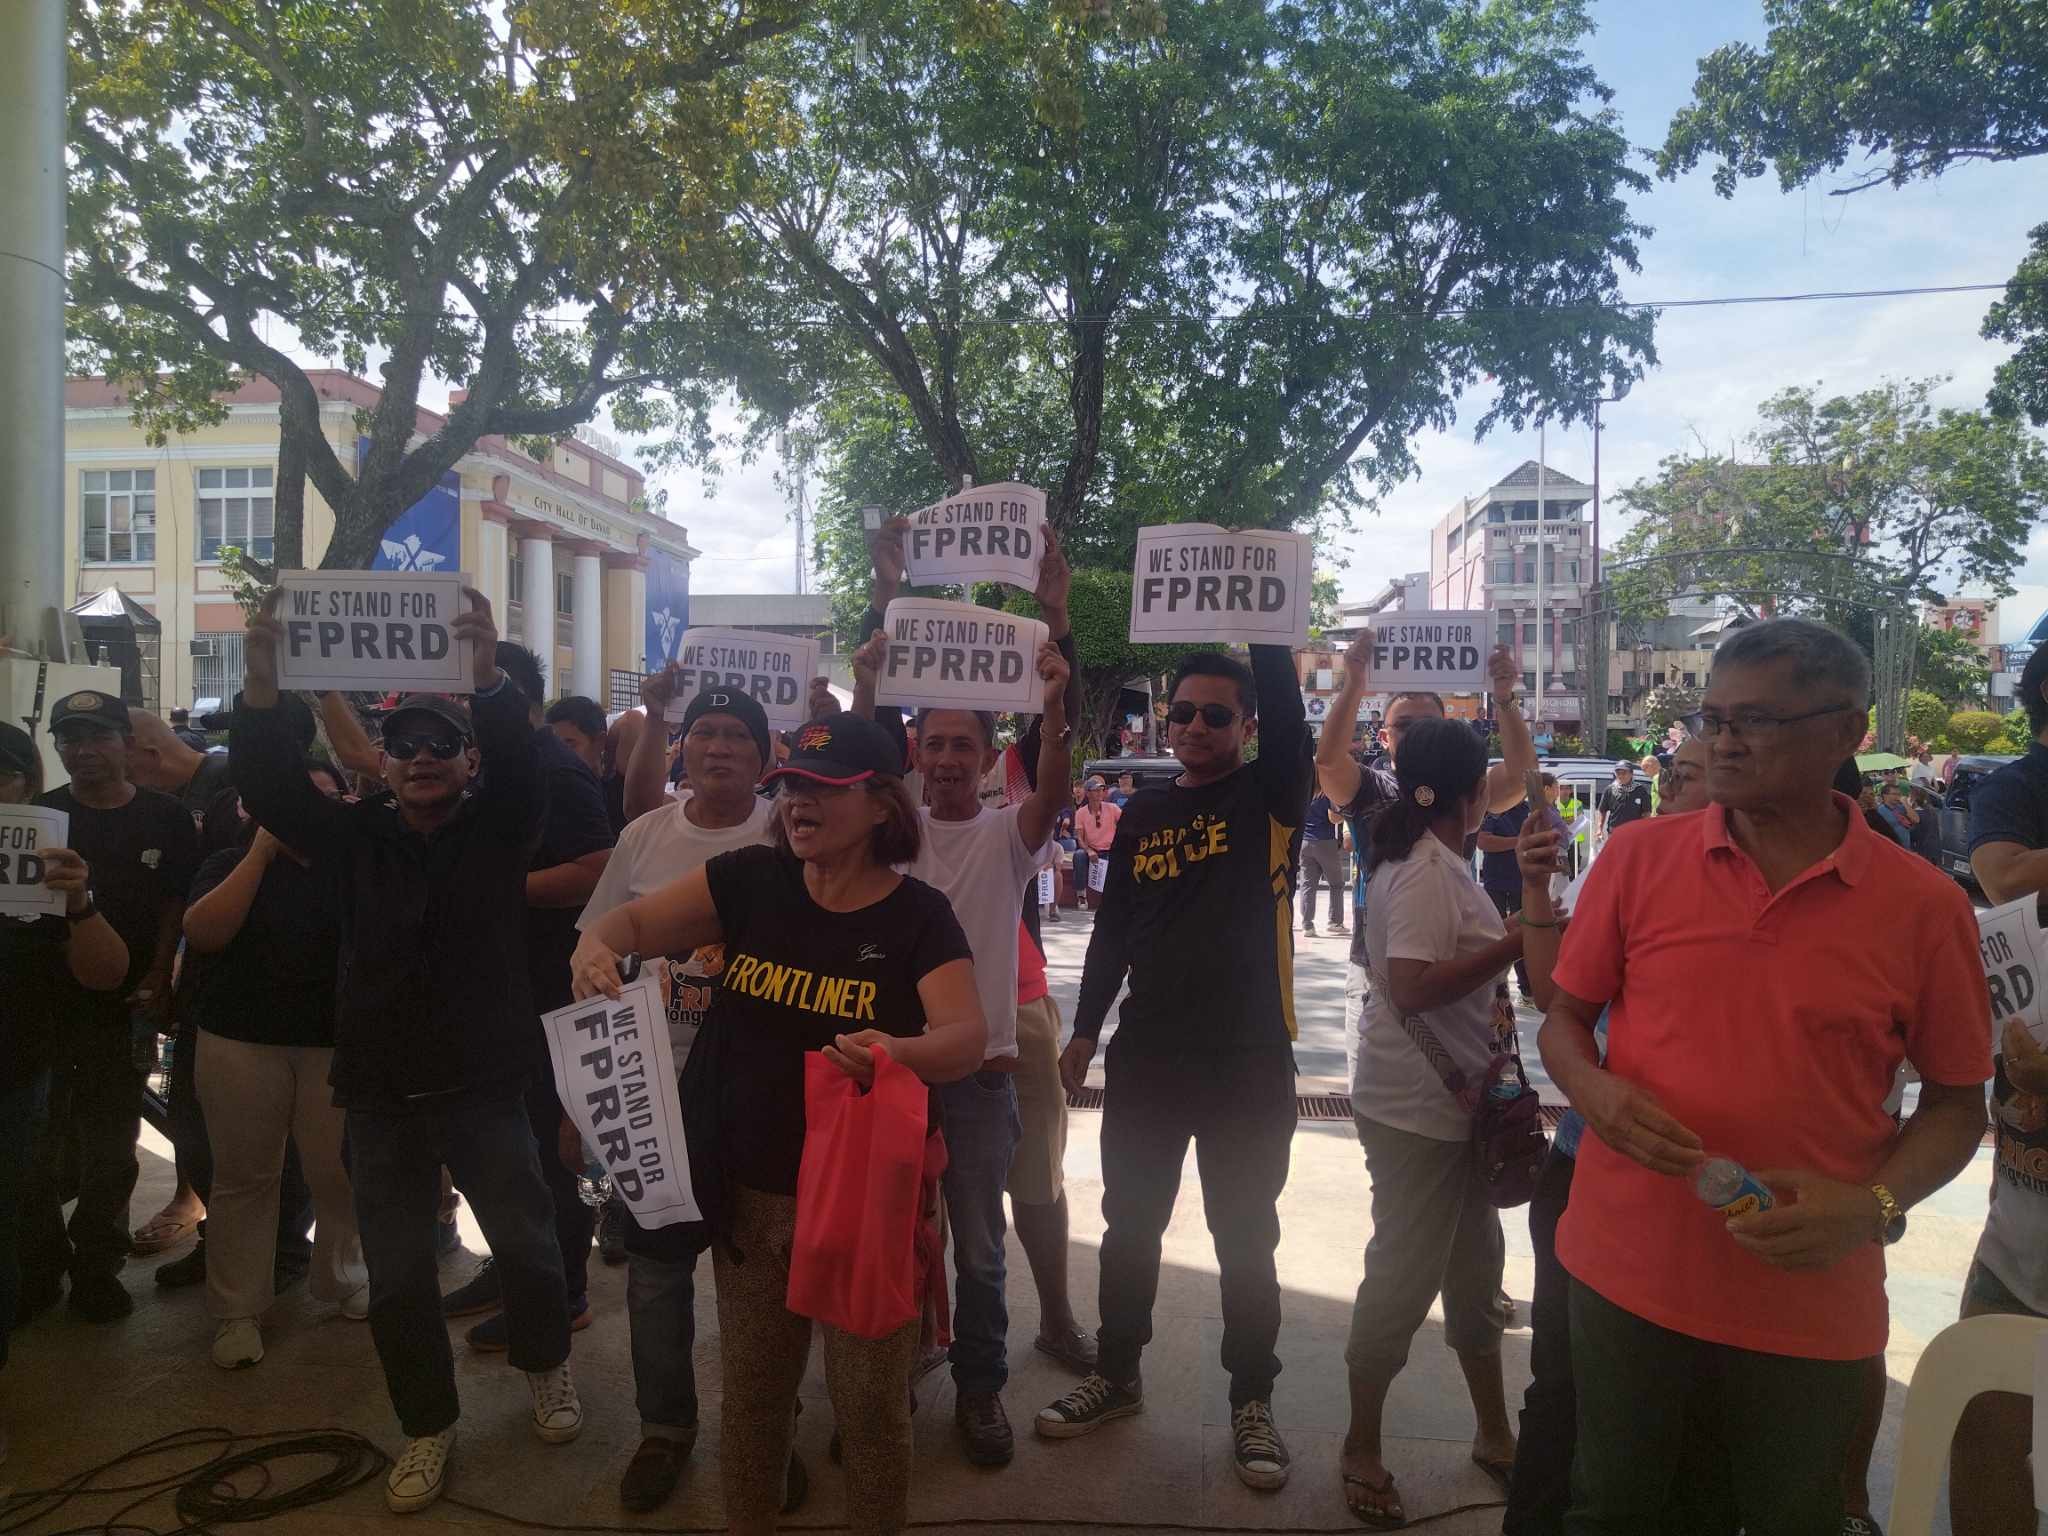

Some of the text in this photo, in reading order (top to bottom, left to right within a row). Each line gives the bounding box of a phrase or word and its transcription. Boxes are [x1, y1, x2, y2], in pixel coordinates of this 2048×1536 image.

[918, 501, 1027, 525] WE STAND FOR
[912, 525, 1032, 560] FPRRD
[1150, 546, 1276, 573] WE STAND FOR
[293, 590, 437, 618] WE STAND FOR
[1142, 575, 1286, 613] FPRRD
[288, 621, 449, 660] FPRRD
[895, 618, 1015, 646] WE STAND FOR
[1377, 625, 1472, 643] WE STAND FOR
[684, 646, 791, 673] WE STAND FOR
[888, 645, 1024, 683] FPRRD
[1373, 646, 1479, 670] FPRRD
[1, 826, 37, 850] FOR
[1133, 821, 1229, 883] POLCE
[723, 954, 877, 1020] FRONTLINER
[574, 1009, 645, 1202] FPRRD
[612, 1005, 665, 1185] WE STAND FOR
